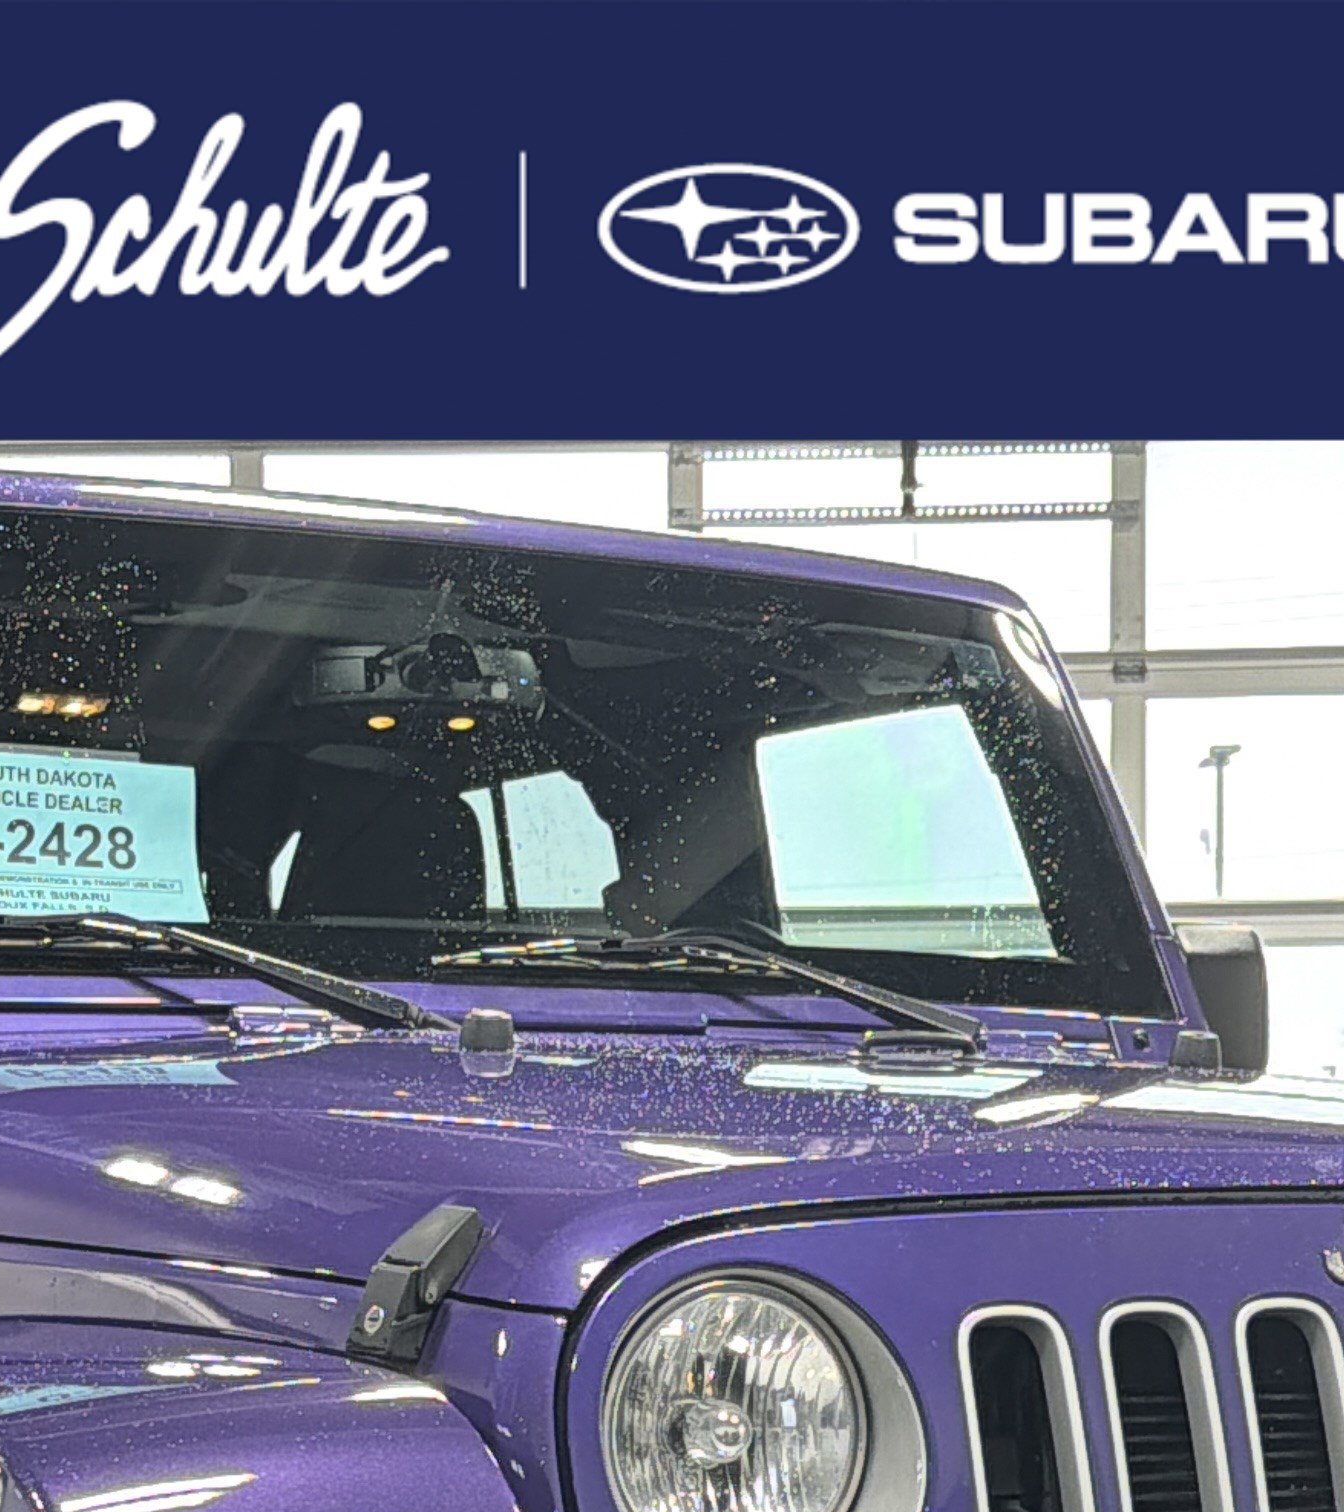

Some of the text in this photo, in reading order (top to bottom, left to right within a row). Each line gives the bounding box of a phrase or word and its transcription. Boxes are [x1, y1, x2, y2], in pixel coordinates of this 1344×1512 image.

[36, 766, 117, 790] DAKOTA
[45, 792, 123, 814] DEALER
[49, 891, 111, 903] SUBARU
